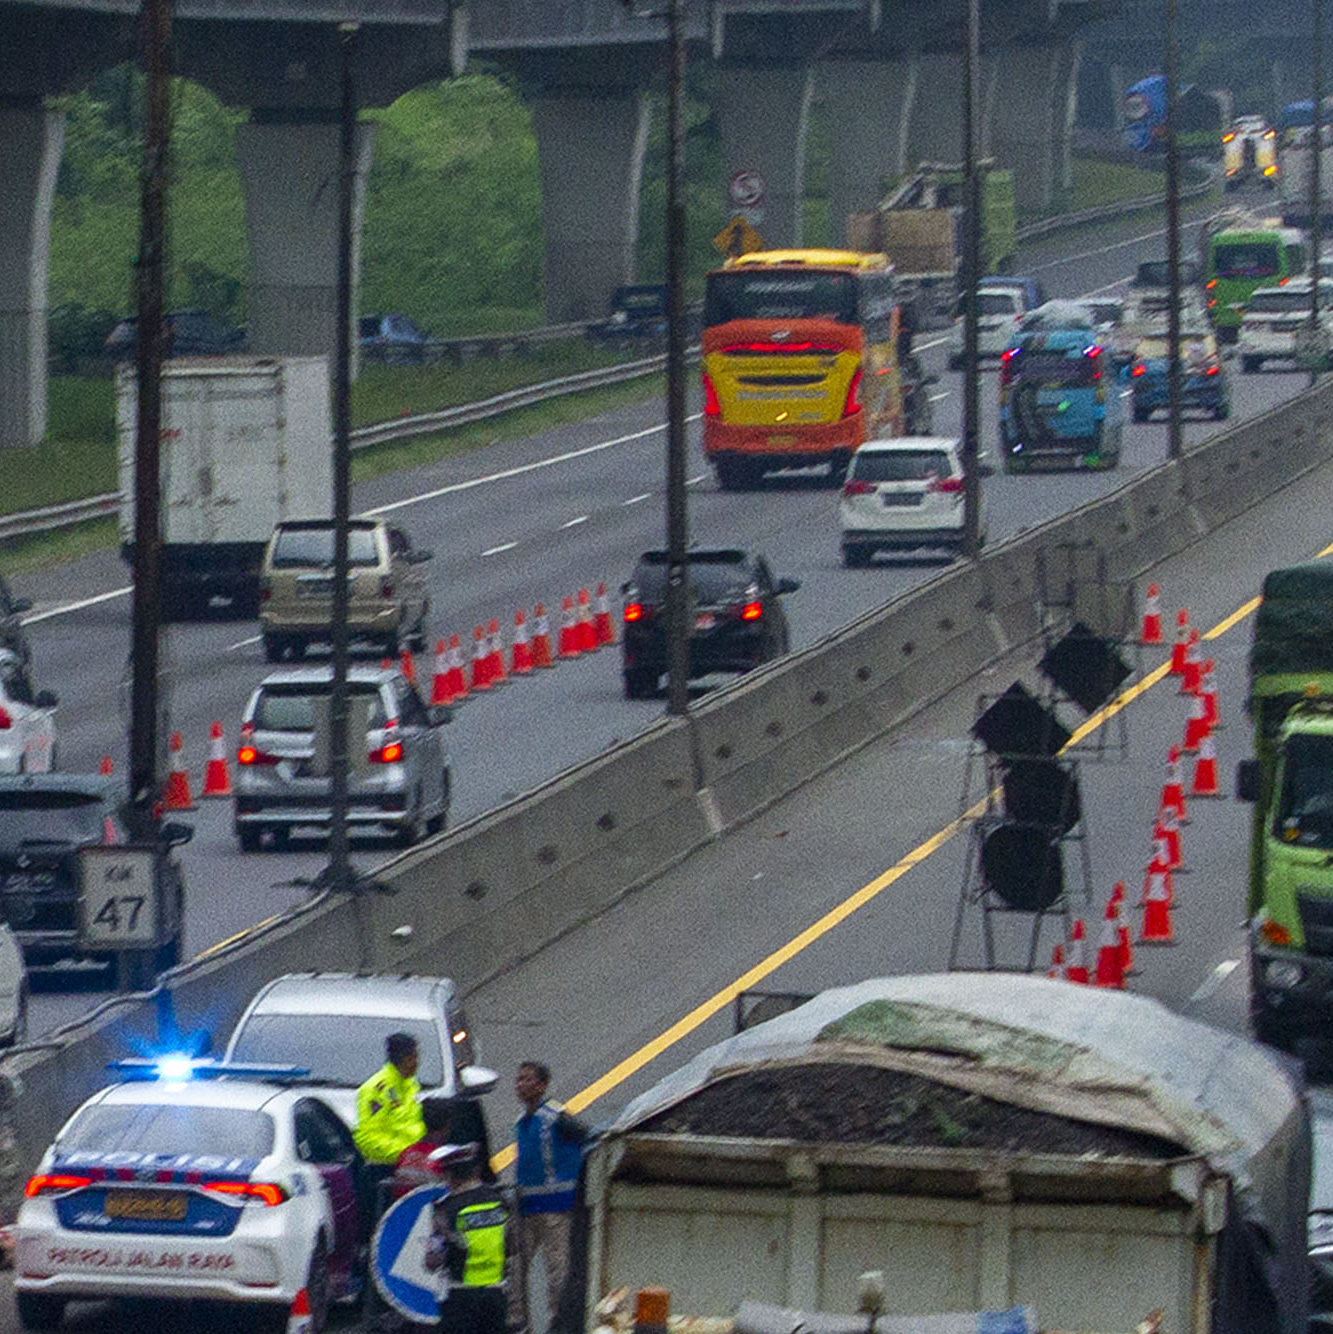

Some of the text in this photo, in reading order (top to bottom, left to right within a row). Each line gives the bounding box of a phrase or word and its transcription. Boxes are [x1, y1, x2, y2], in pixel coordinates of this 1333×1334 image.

[92, 895, 148, 932] 47
[65, 1151, 245, 1171] POLISI
[127, 1249, 184, 1269] JALAN
[187, 1252, 236, 1270] RAYA
